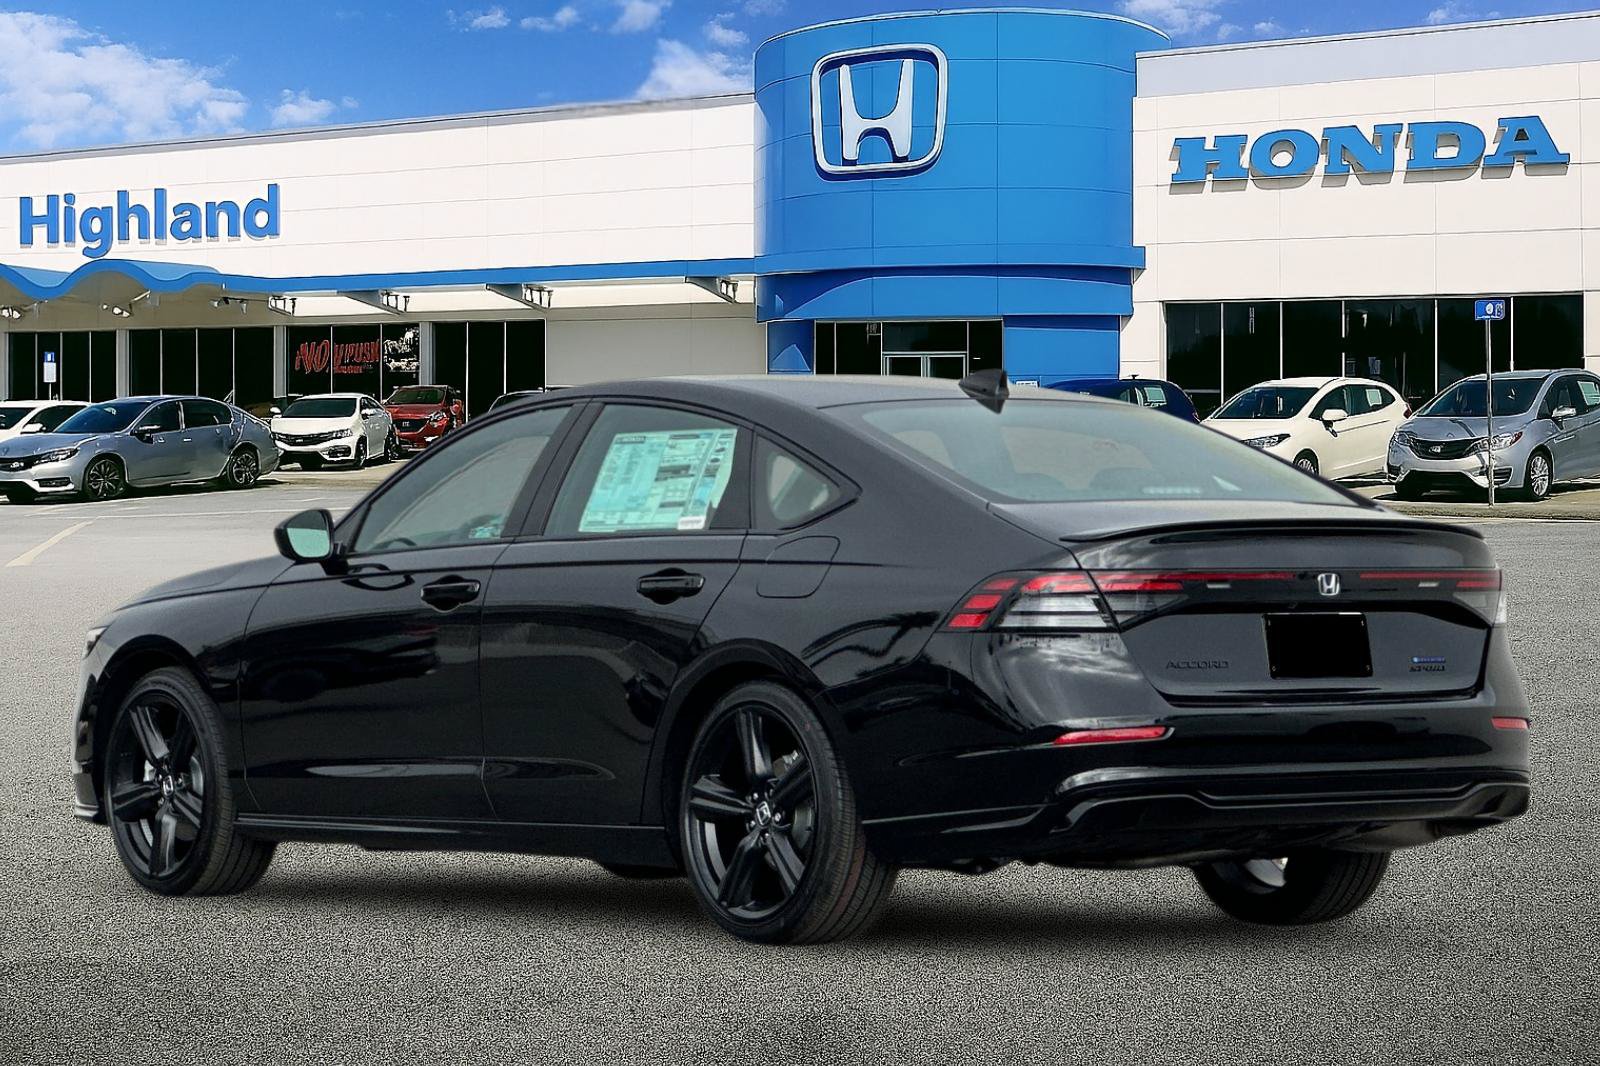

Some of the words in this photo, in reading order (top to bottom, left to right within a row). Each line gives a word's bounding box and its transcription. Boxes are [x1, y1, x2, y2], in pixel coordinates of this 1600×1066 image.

[1171, 115, 1571, 182] HONDA
[19, 183, 280, 258] Highland
[1166, 660, 1230, 670] ACCORD
